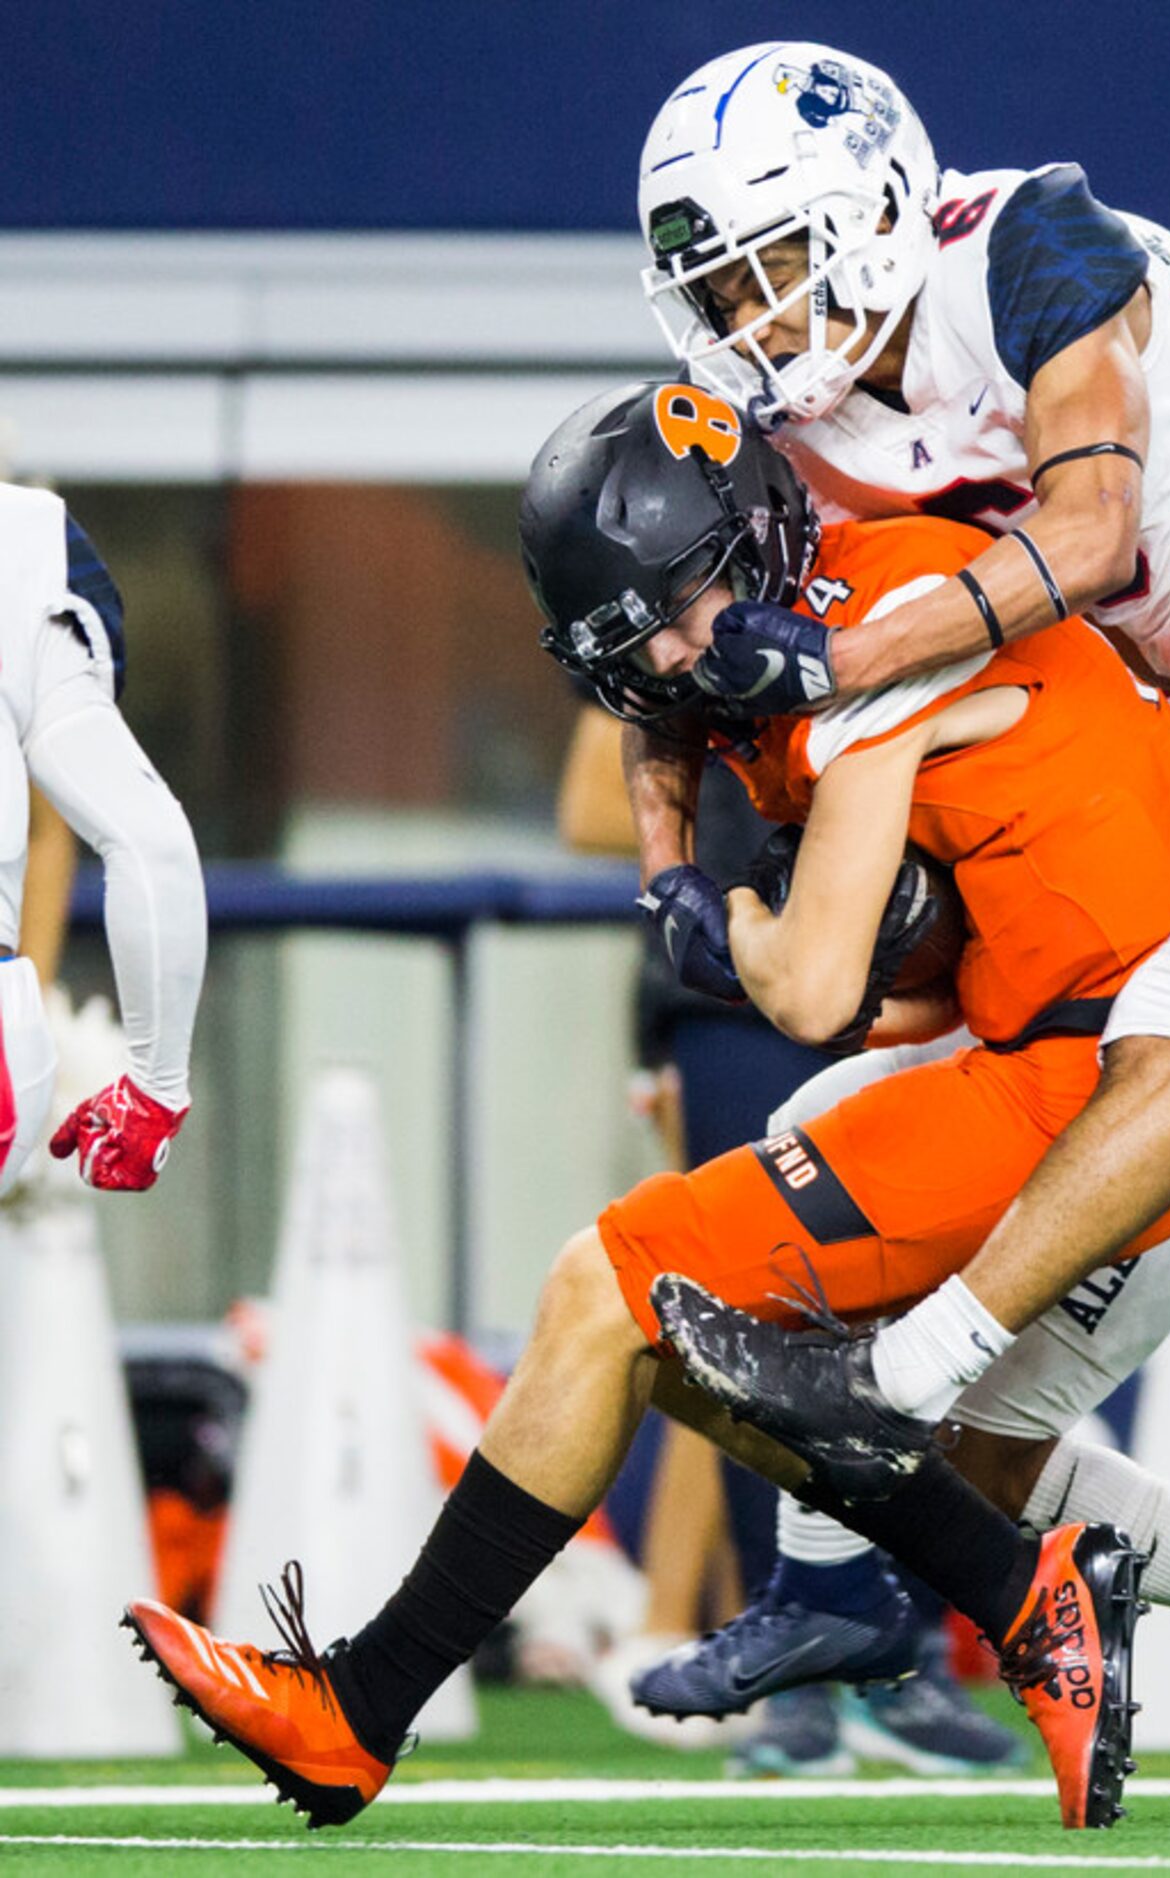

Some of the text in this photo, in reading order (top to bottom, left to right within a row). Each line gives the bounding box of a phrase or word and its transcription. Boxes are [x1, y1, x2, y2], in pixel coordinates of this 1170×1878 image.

[936, 187, 998, 252] 6
[654, 383, 742, 467] B
[910, 438, 933, 470] A
[803, 575, 855, 618] 4
[1054, 1580, 1096, 1710] adidas
